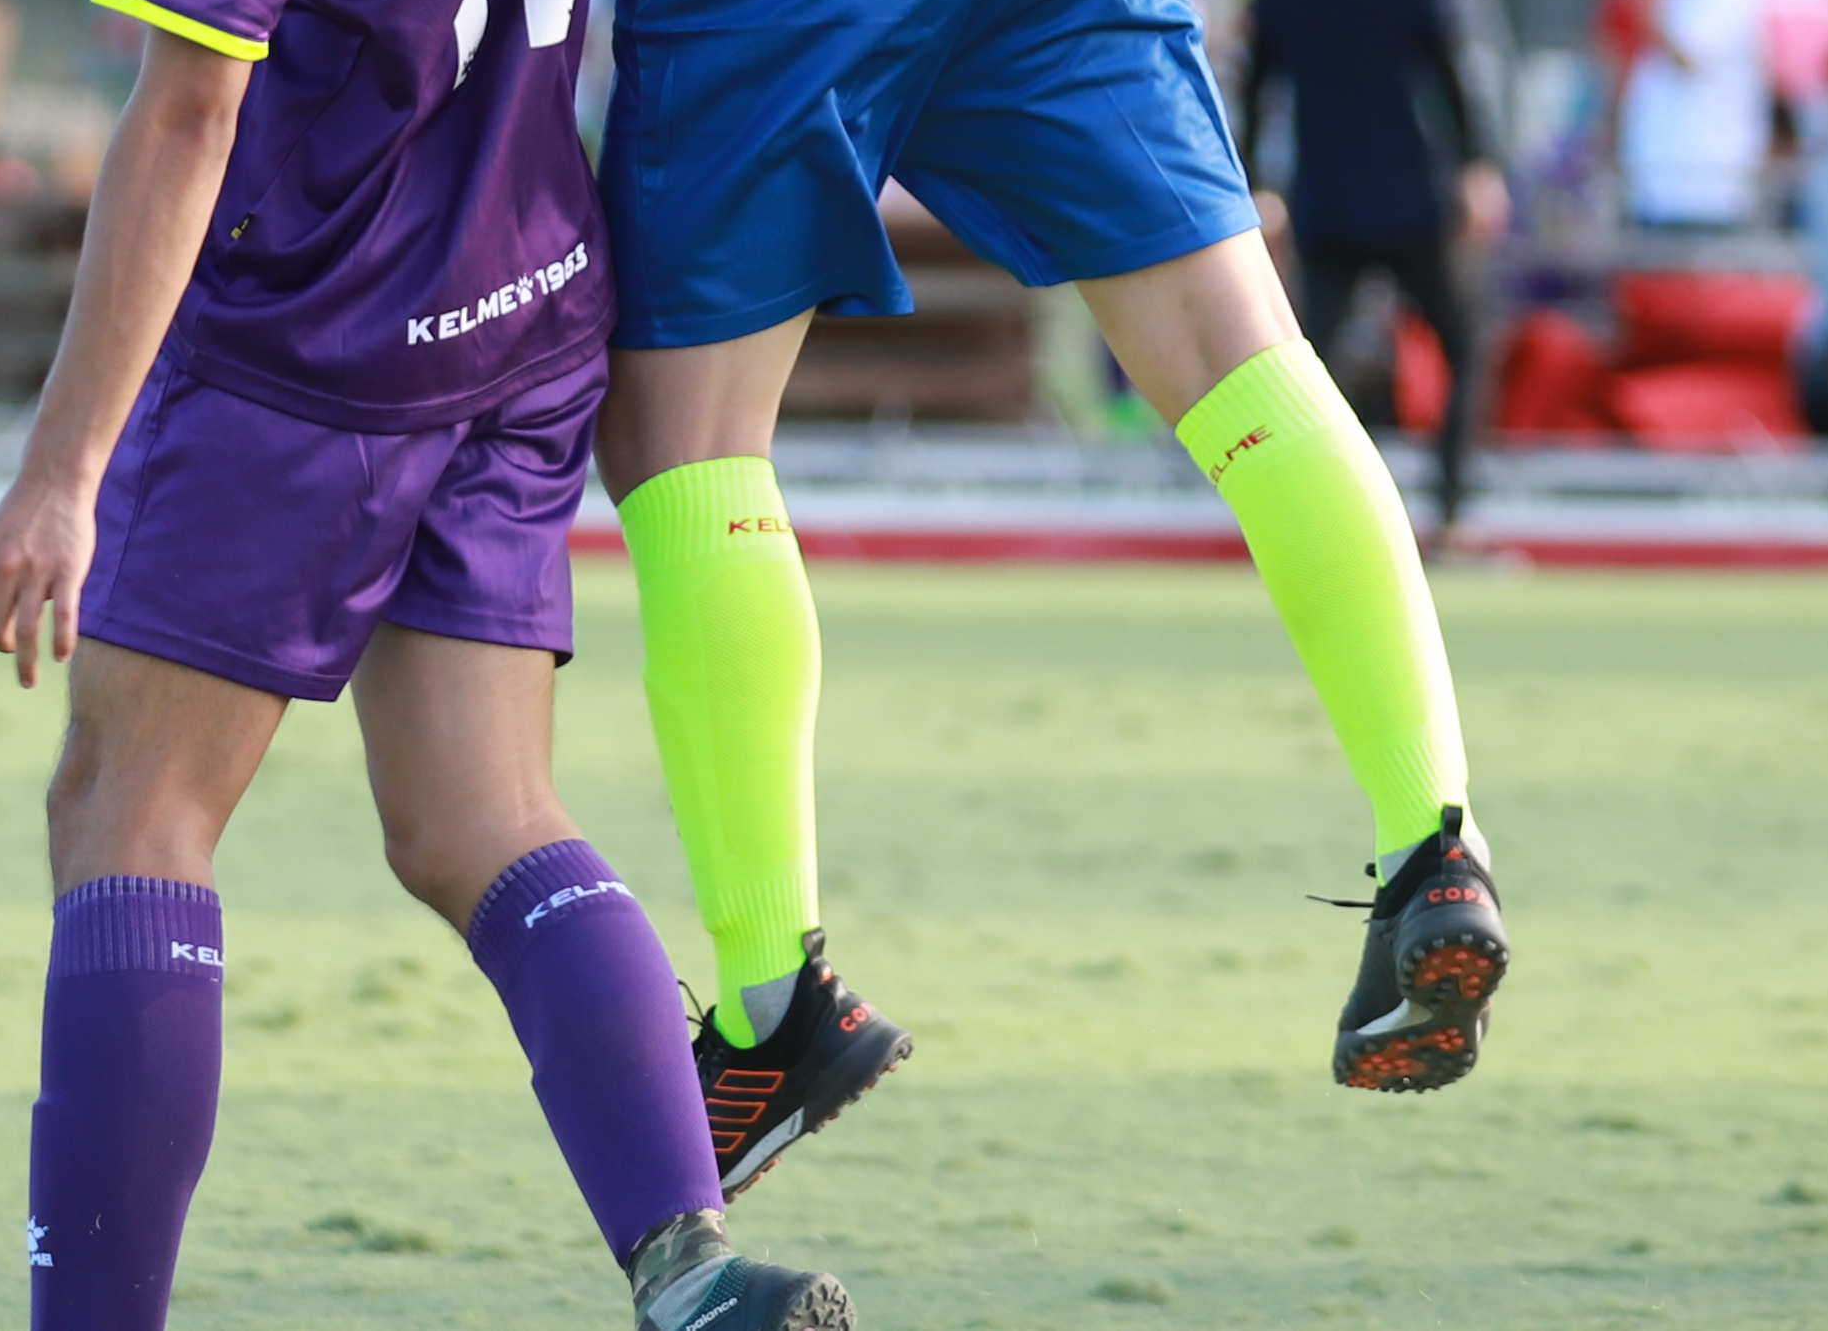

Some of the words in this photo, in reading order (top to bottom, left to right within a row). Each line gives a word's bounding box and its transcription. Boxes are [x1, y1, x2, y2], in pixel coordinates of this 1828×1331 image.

[407, 273, 518, 345] KELME
[1210, 424, 1274, 485] ELME
[728, 517, 792, 536] KEL
[524, 880, 634, 929] KELM
[171, 940, 225, 968] KEL
